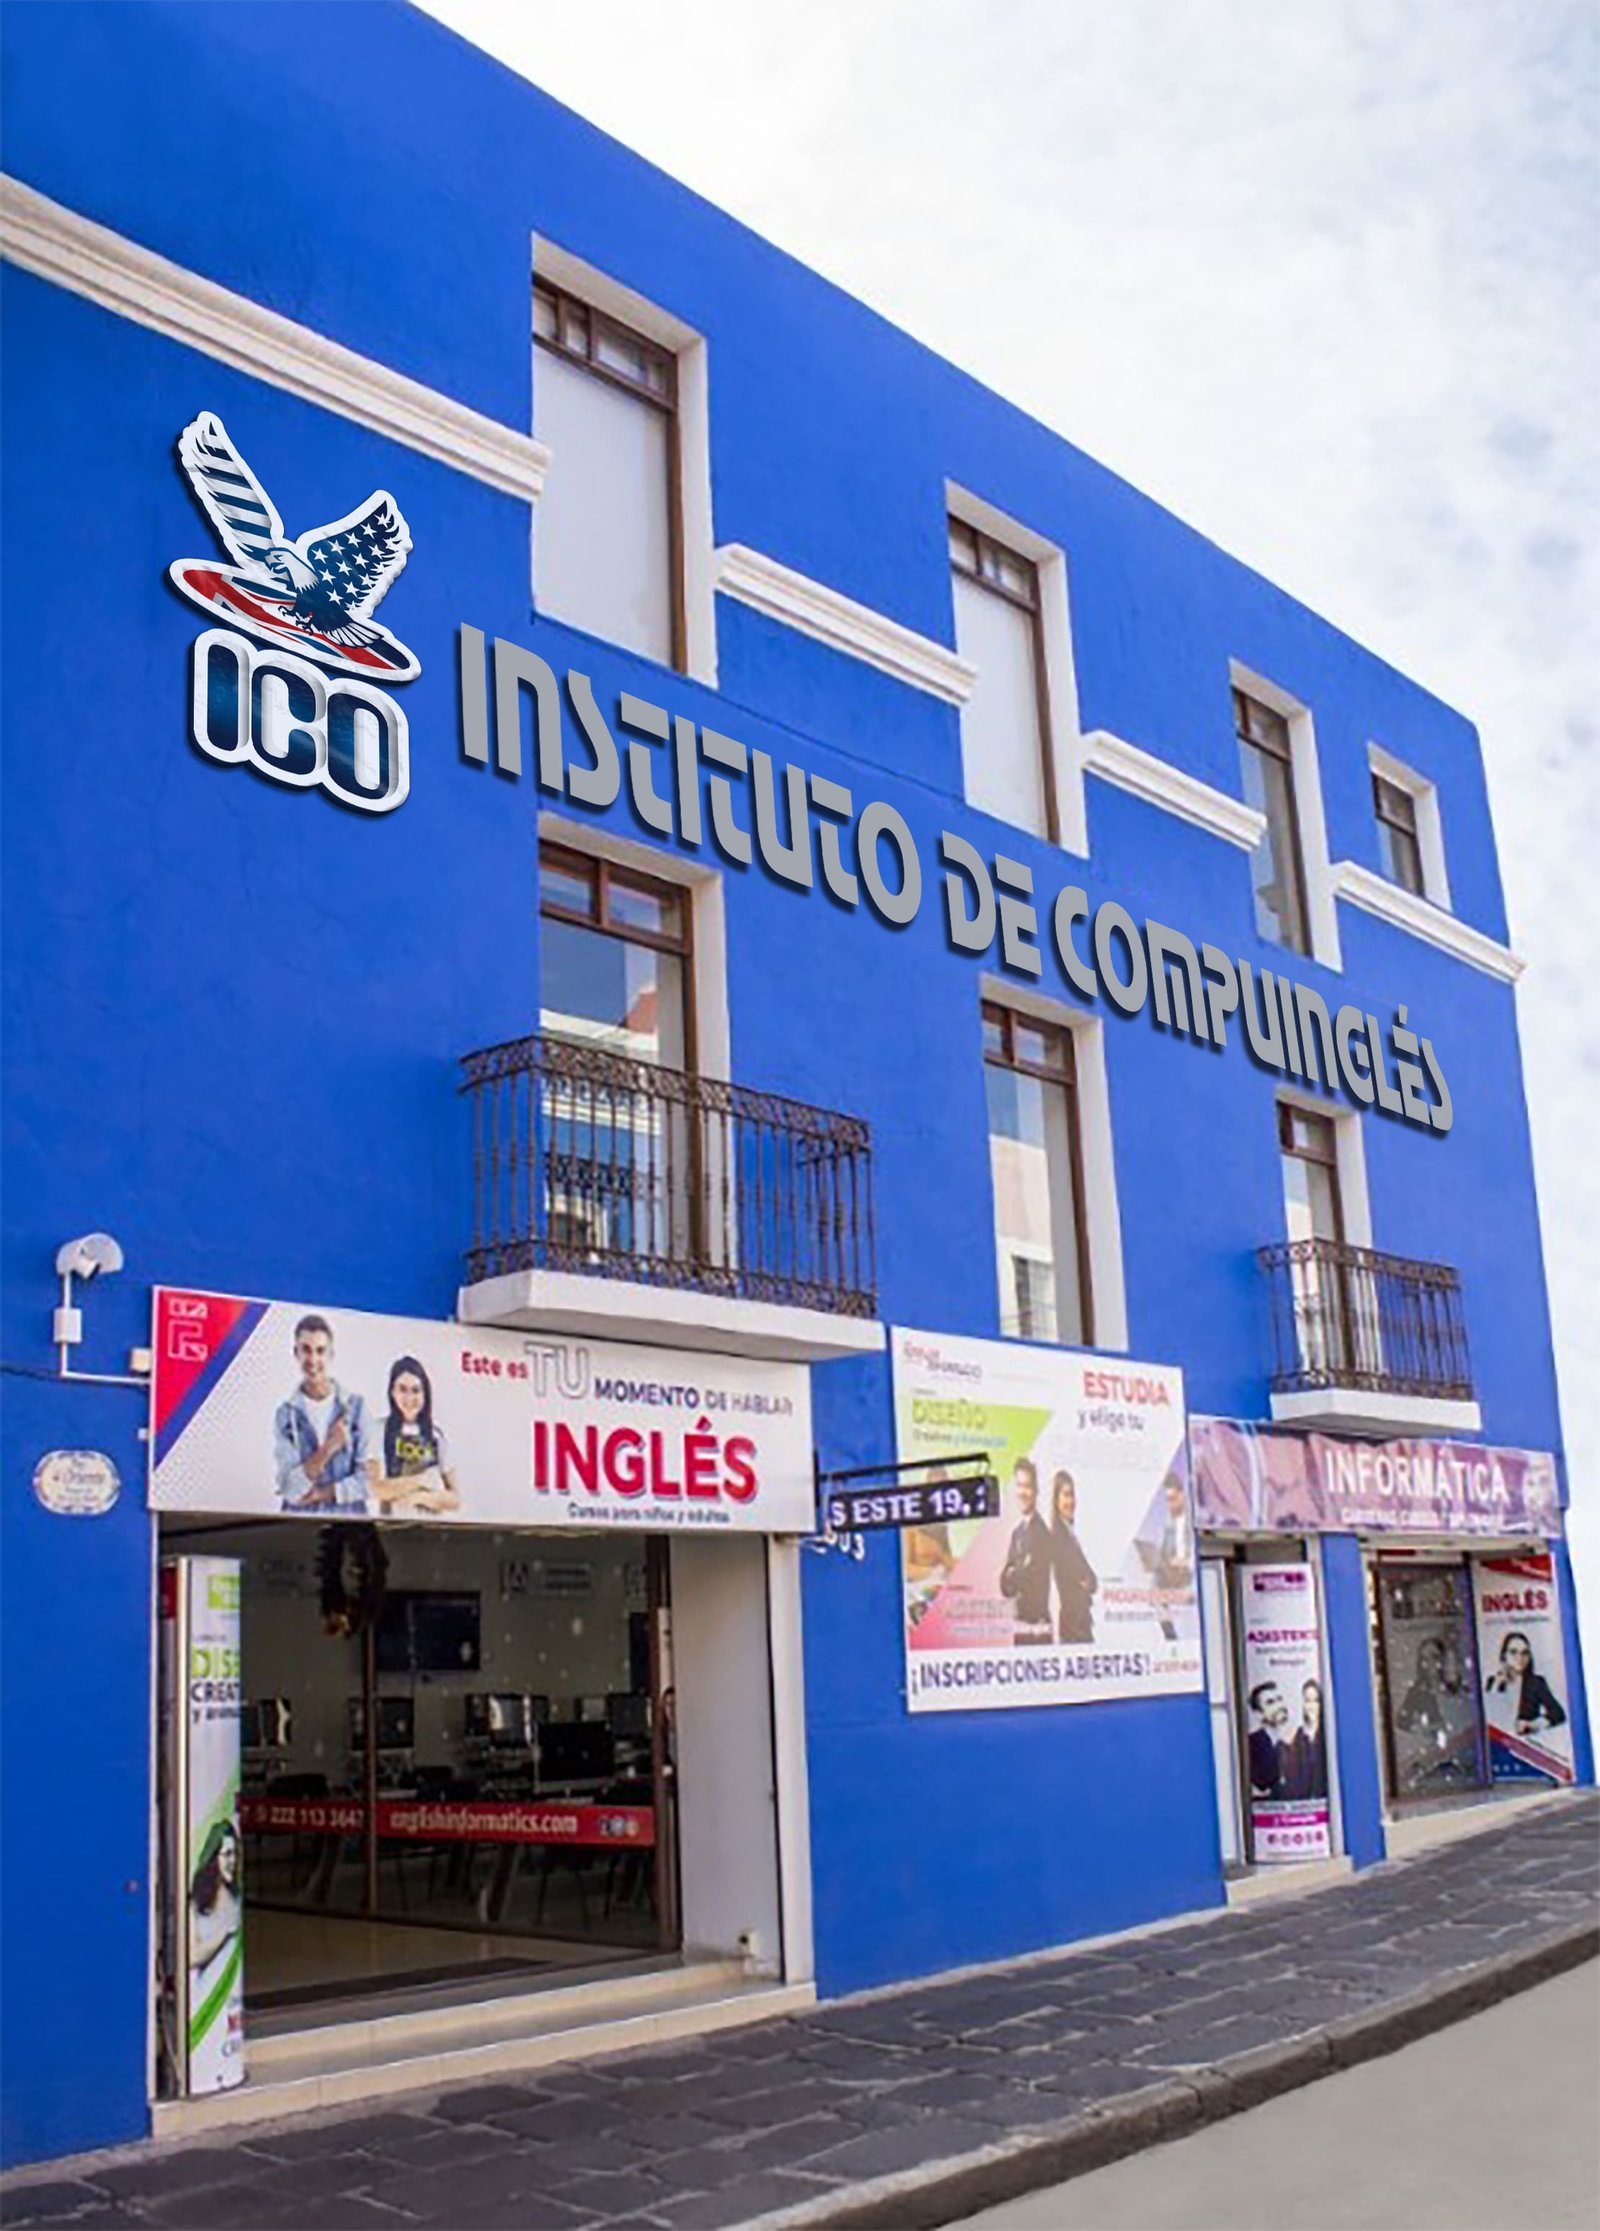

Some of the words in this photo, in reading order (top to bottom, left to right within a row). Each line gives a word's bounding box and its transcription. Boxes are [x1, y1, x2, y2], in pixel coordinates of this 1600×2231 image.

[194, 629, 409, 812] ICO
[460, 622, 922, 925] INSTITUTO
[942, 829, 1042, 976] DE
[1054, 885, 1454, 1132] COMPUINGLÉS
[461, 1352, 500, 1377] Este
[507, 1362, 529, 1379] es
[524, 1341, 591, 1400] TU
[595, 1377, 701, 1409] MOMENTO
[704, 1390, 728, 1412] DE
[731, 1394, 794, 1417] HABLAR
[1084, 1370, 1170, 1407] ESTUDIA
[1077, 1408, 1087, 1430] y
[533, 1415, 758, 1504] INGLÉS
[1326, 1446, 1510, 1503] INFORMÁTICA
[852, 1492, 922, 1524] ESTE
[1482, 1586, 1548, 1613] INGLÉS
[1064, 1652, 1151, 1680] ABIERTAS!
